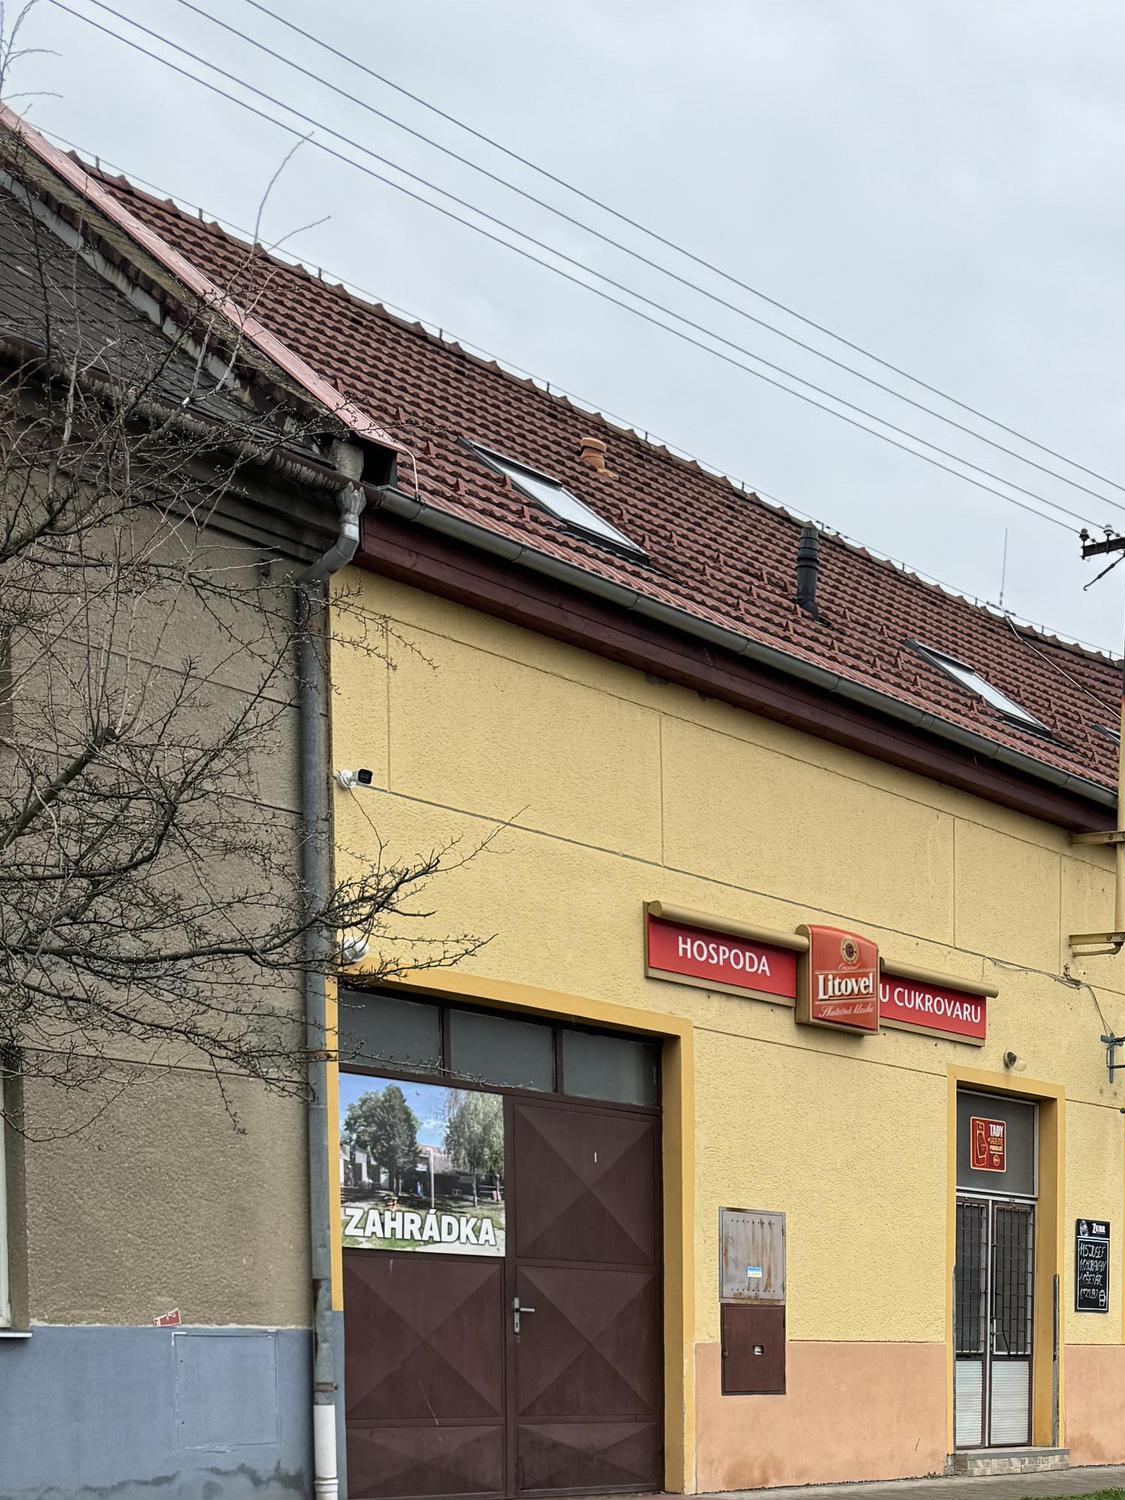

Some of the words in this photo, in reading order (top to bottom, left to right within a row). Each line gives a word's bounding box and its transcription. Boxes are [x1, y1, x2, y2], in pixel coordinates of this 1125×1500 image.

[678, 936, 770, 977] HOSPODA
[817, 973, 874, 999] Litovel
[880, 984, 889, 1003] U
[894, 988, 982, 1024] CUKROVARU
[344, 1207, 496, 1246] ZAHRÁDKA
